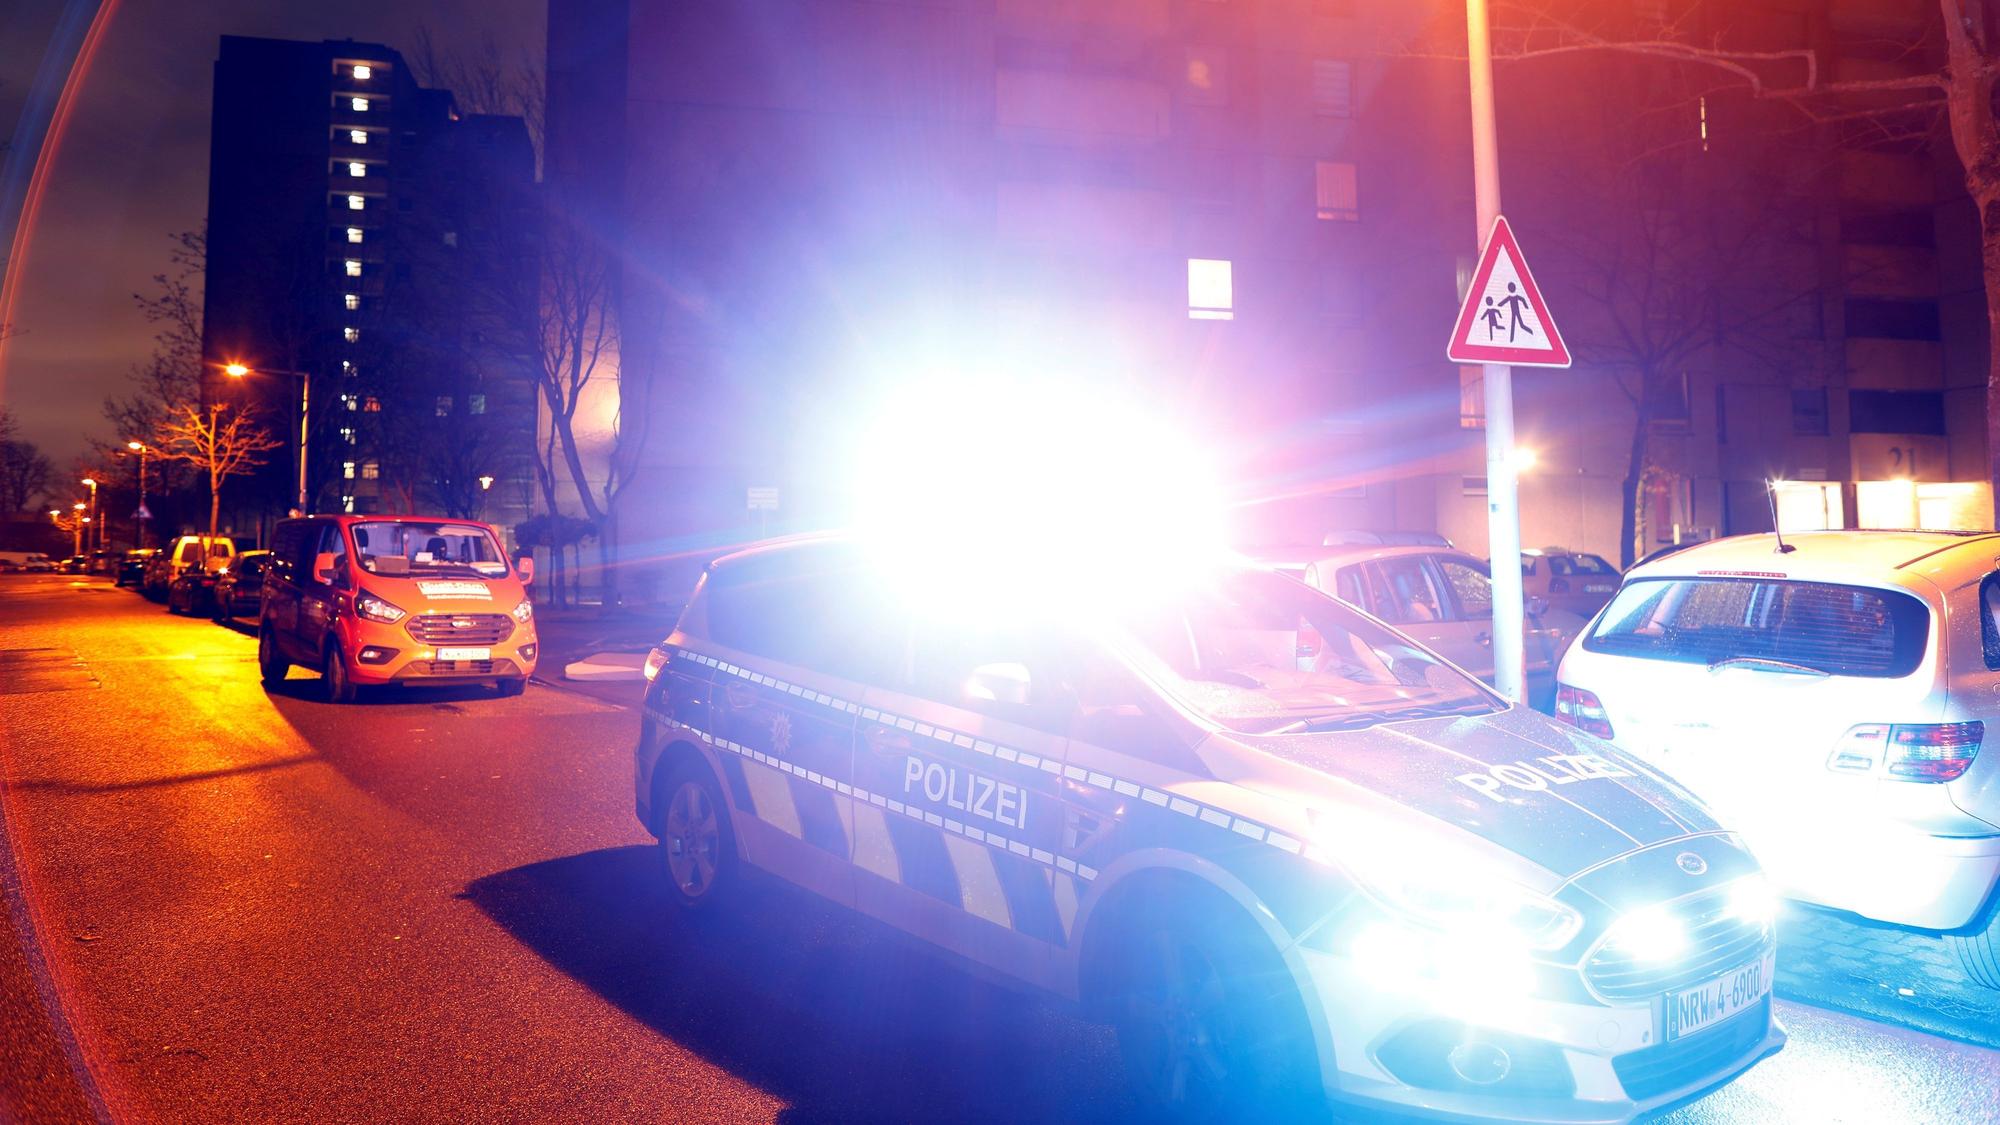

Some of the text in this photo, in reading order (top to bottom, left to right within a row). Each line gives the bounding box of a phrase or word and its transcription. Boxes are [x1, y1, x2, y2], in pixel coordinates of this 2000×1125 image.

[1888, 447, 1917, 476] 21
[904, 755, 1027, 830] POLIZEI
[1455, 754, 1639, 803] POLIZEI
[1679, 965, 1760, 1031] NRW 4-6900
